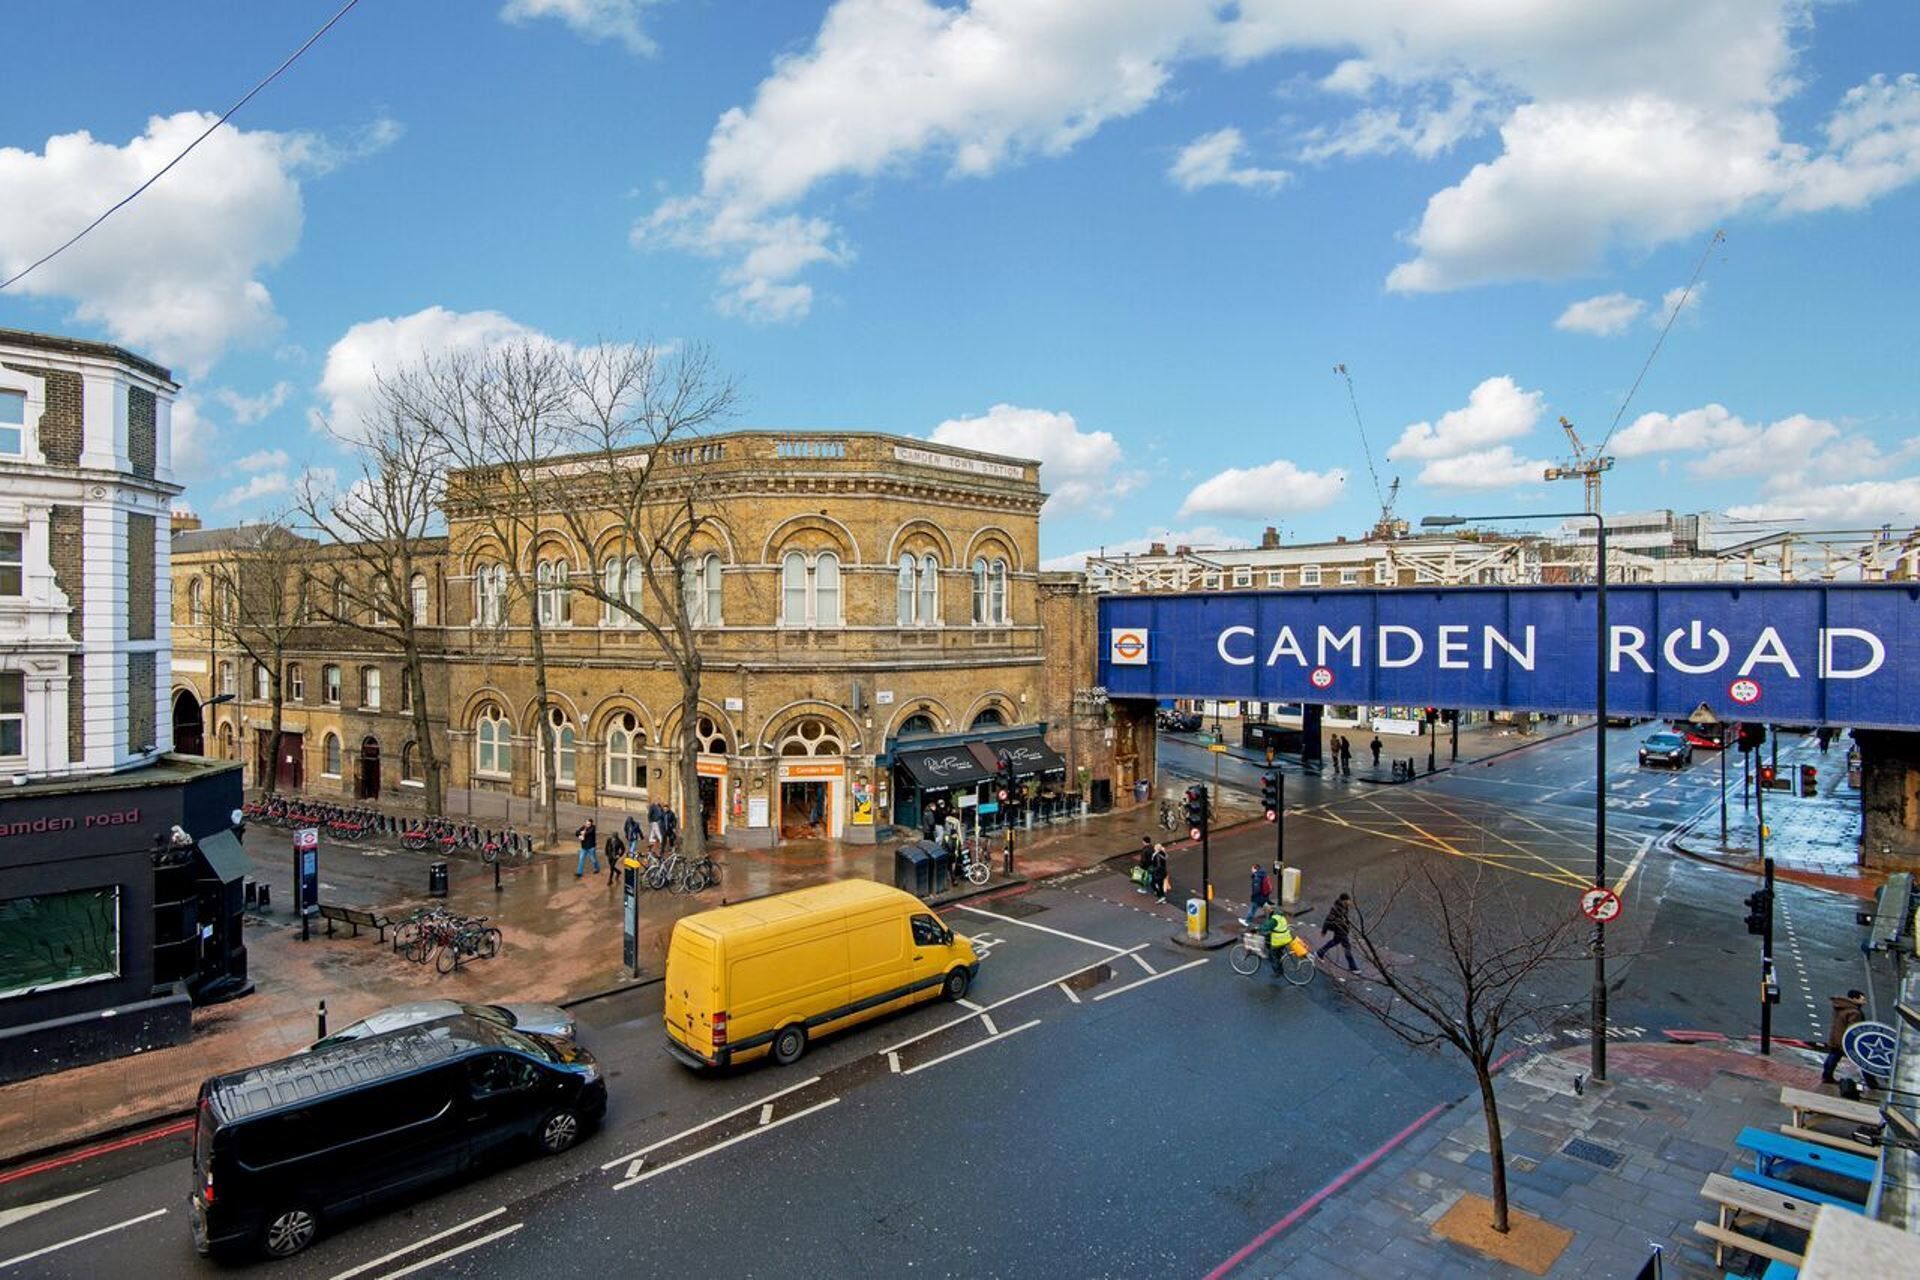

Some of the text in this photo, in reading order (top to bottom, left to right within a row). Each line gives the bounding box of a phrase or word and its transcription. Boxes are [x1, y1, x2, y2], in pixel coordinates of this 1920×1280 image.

[901, 450, 1022, 479] CAMDEN TOWN STATION
[1217, 620, 1886, 679] CAMDEN ROAD
[84, 808, 139, 827] road
